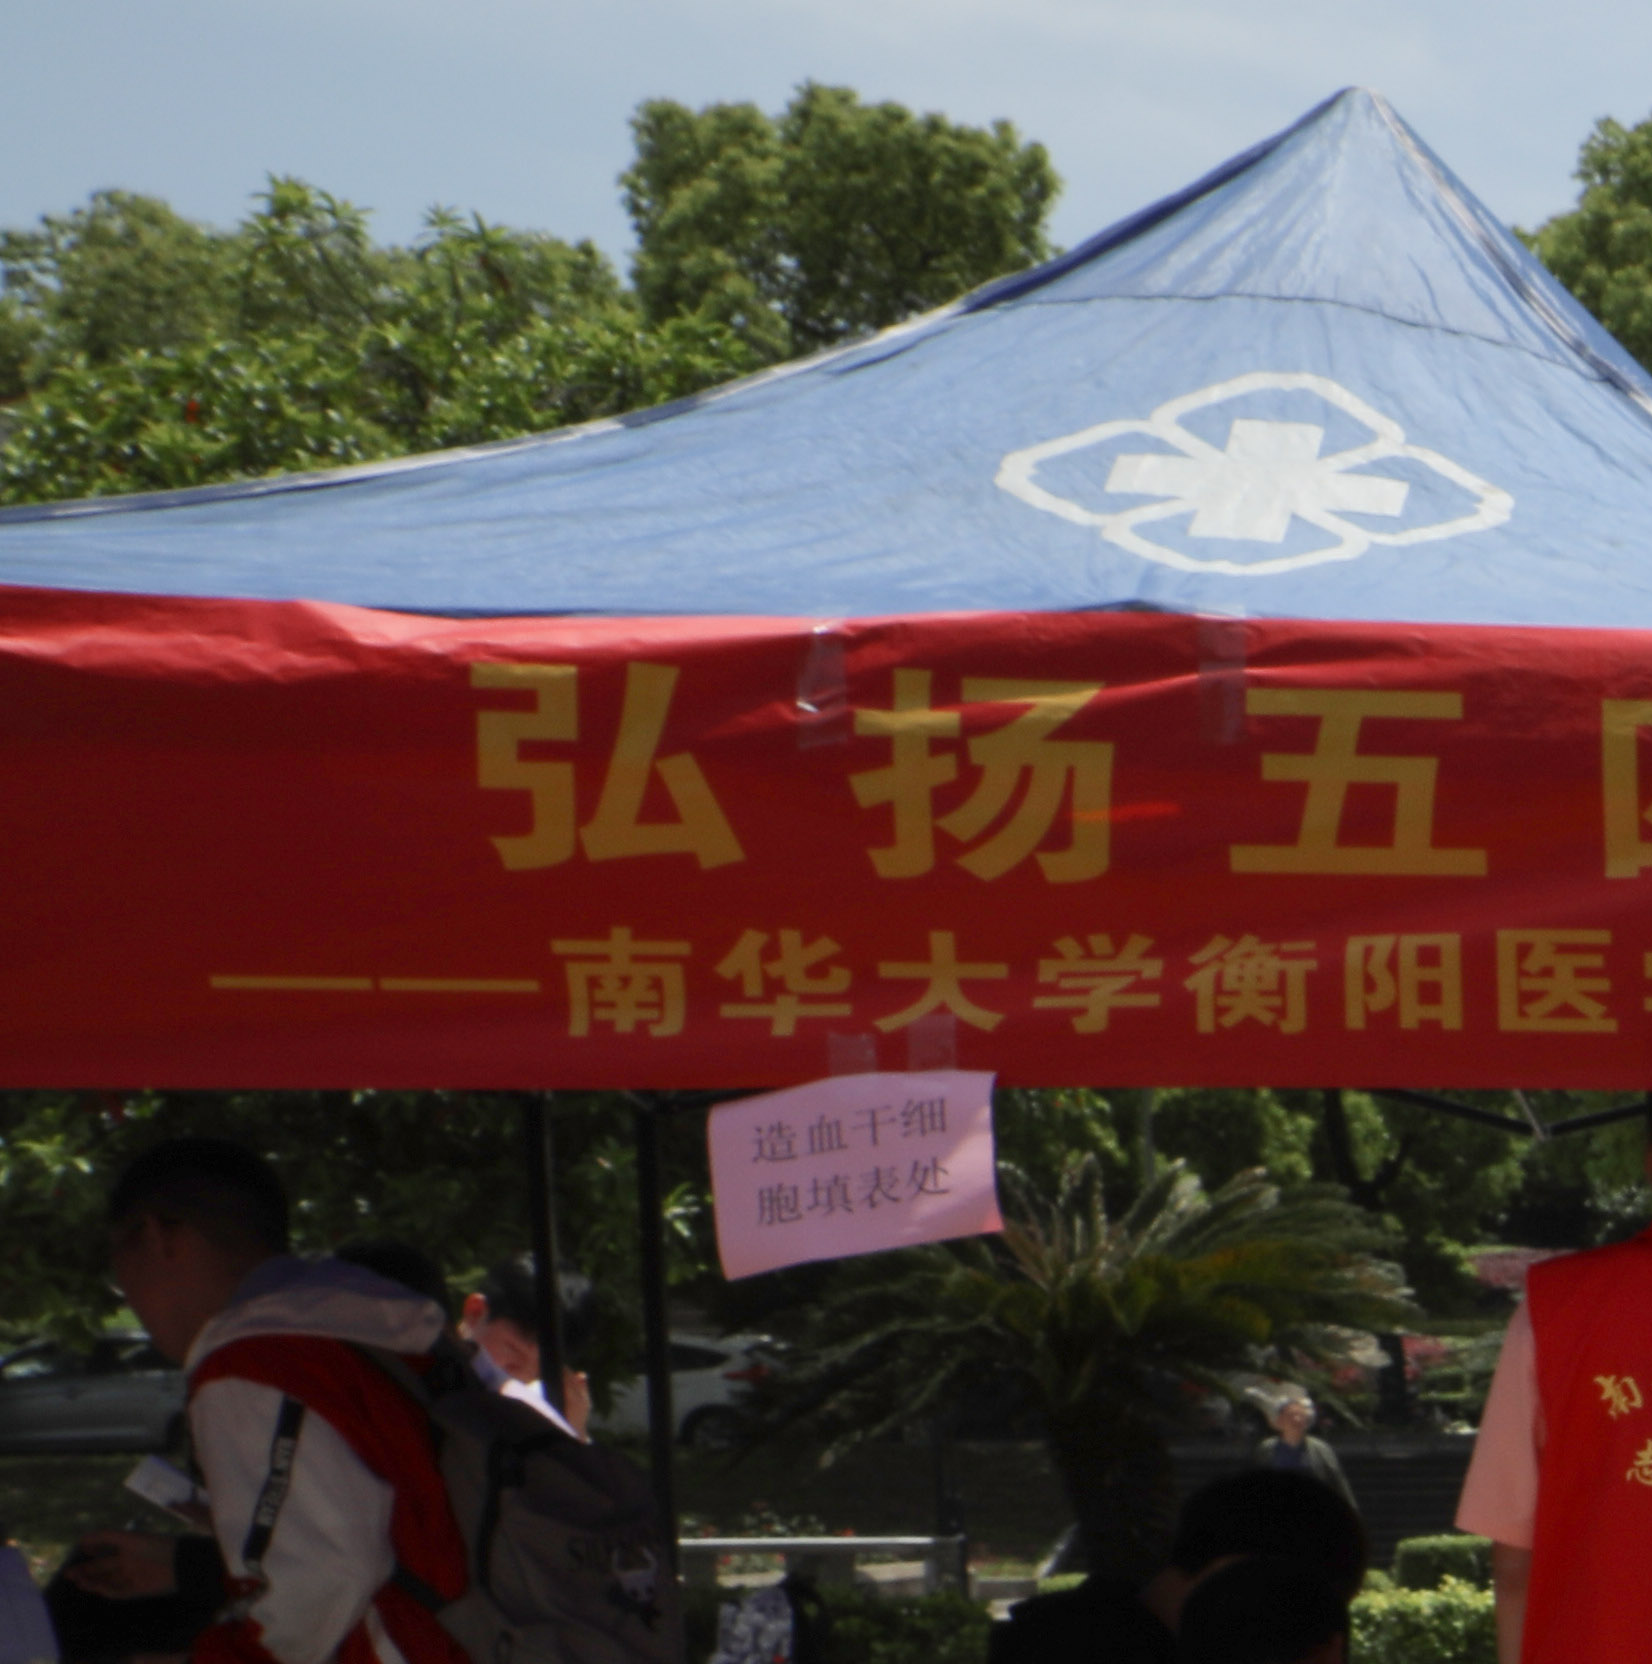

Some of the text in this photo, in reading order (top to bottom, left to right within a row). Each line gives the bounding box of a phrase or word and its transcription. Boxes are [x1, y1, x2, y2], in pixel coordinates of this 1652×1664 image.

[752, 1096, 950, 1166] 造血干细
[757, 1157, 953, 1229] 胞填表处
